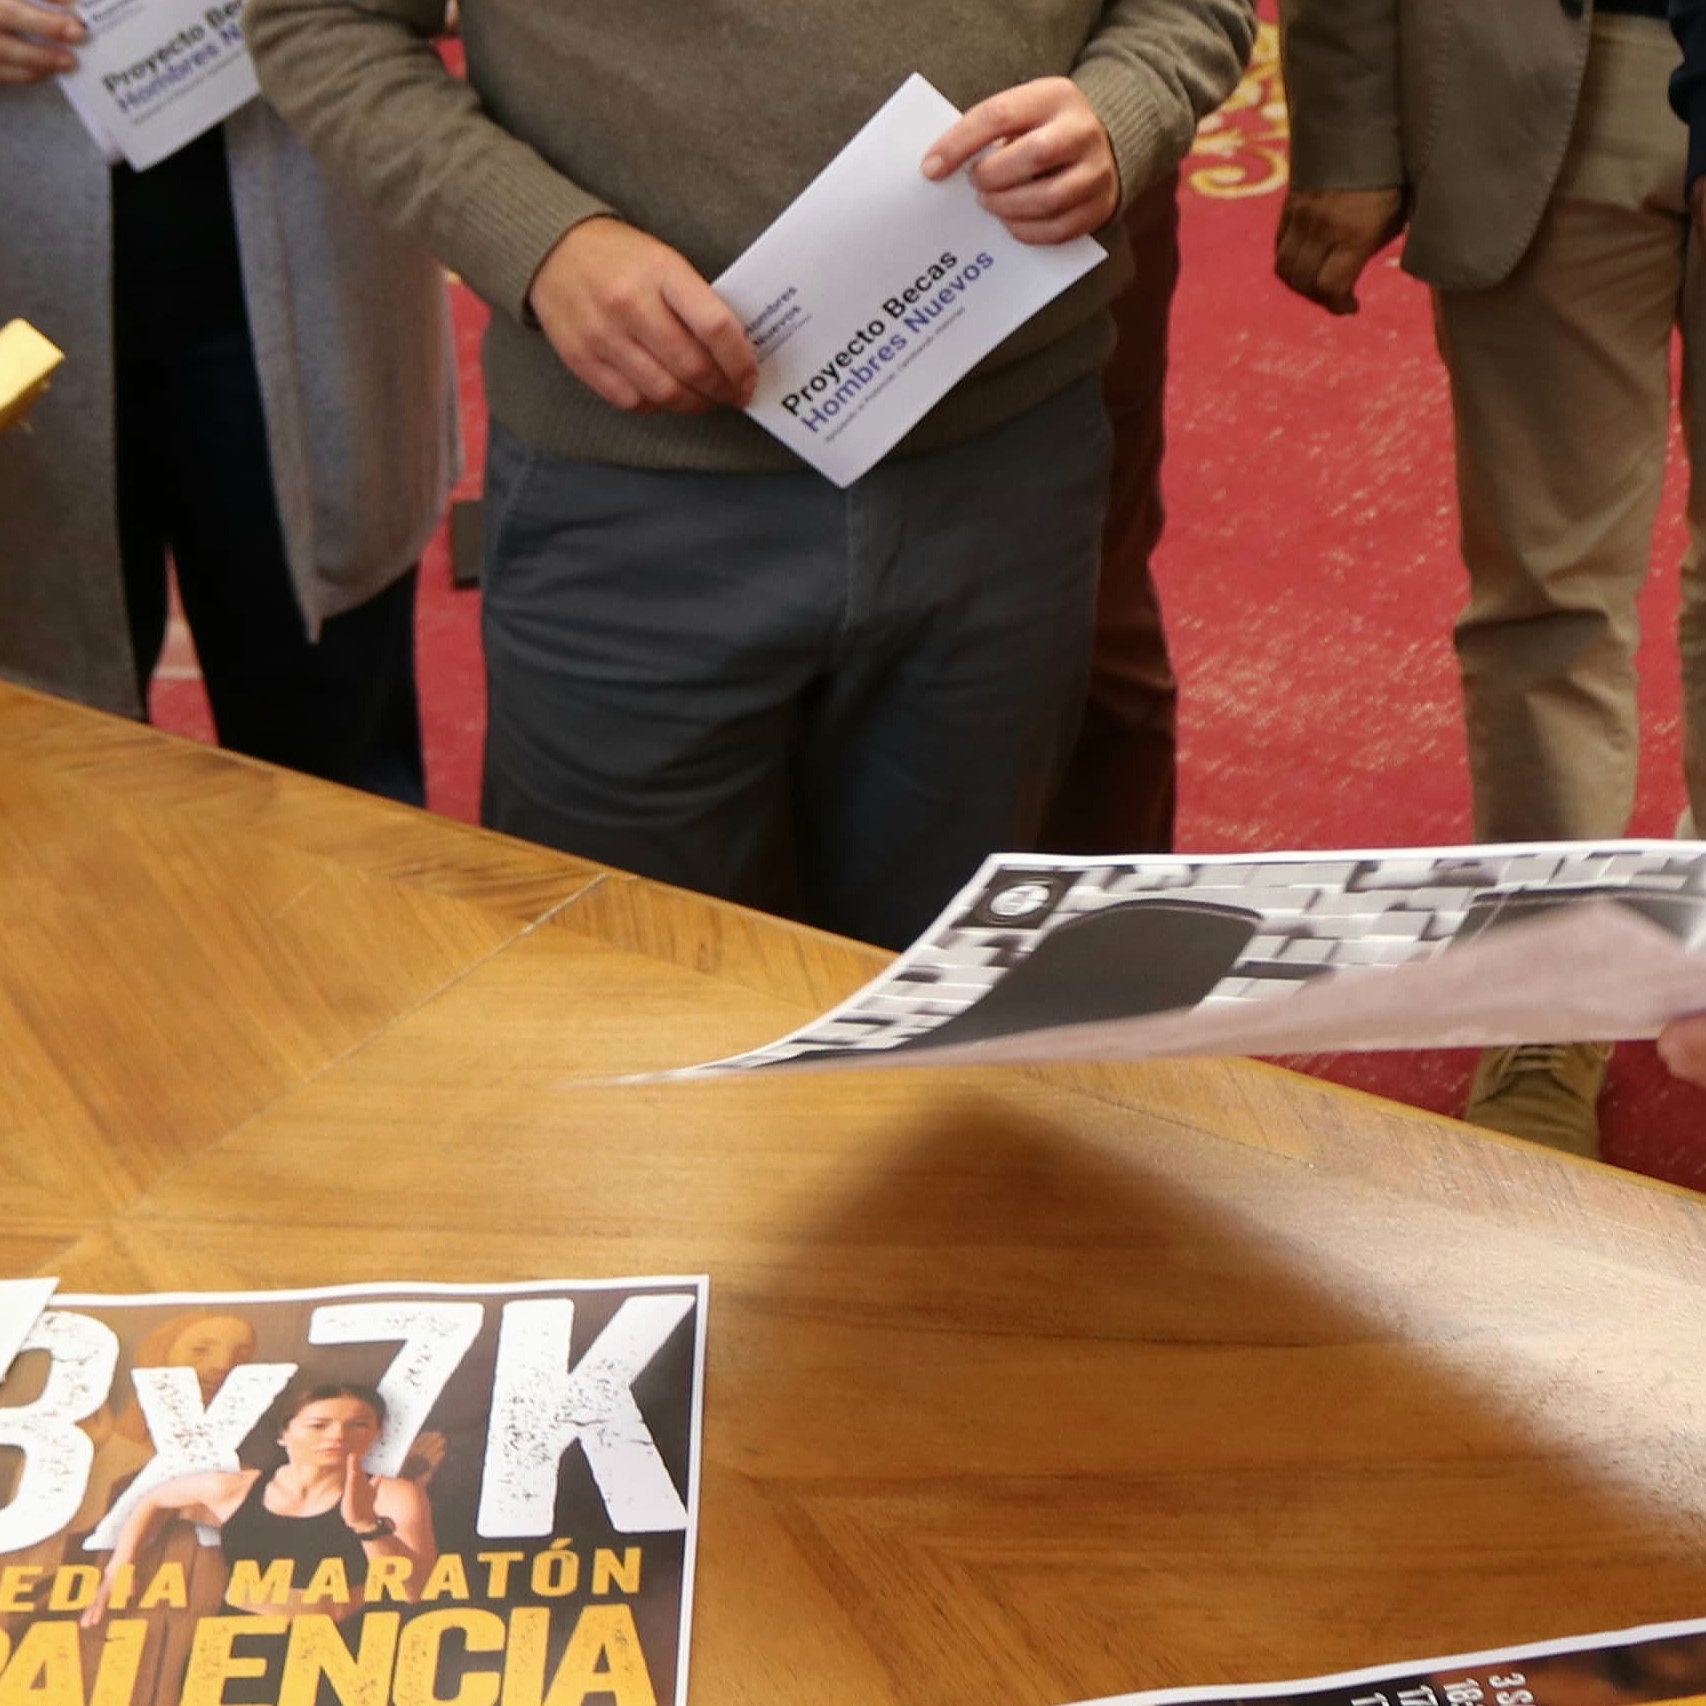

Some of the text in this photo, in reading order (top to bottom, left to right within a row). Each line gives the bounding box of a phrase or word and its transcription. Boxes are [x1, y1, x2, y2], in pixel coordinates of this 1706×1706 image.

[102, 24, 205, 95] Proyecto
[116, 44, 219, 112] Hombres
[781, 319, 886, 417] Proyecto
[882, 252, 957, 319] Becas
[801, 333, 907, 433] Hombres
[903, 252, 994, 333] Nuevos
[225, 1536, 644, 1610] MARATÓN
